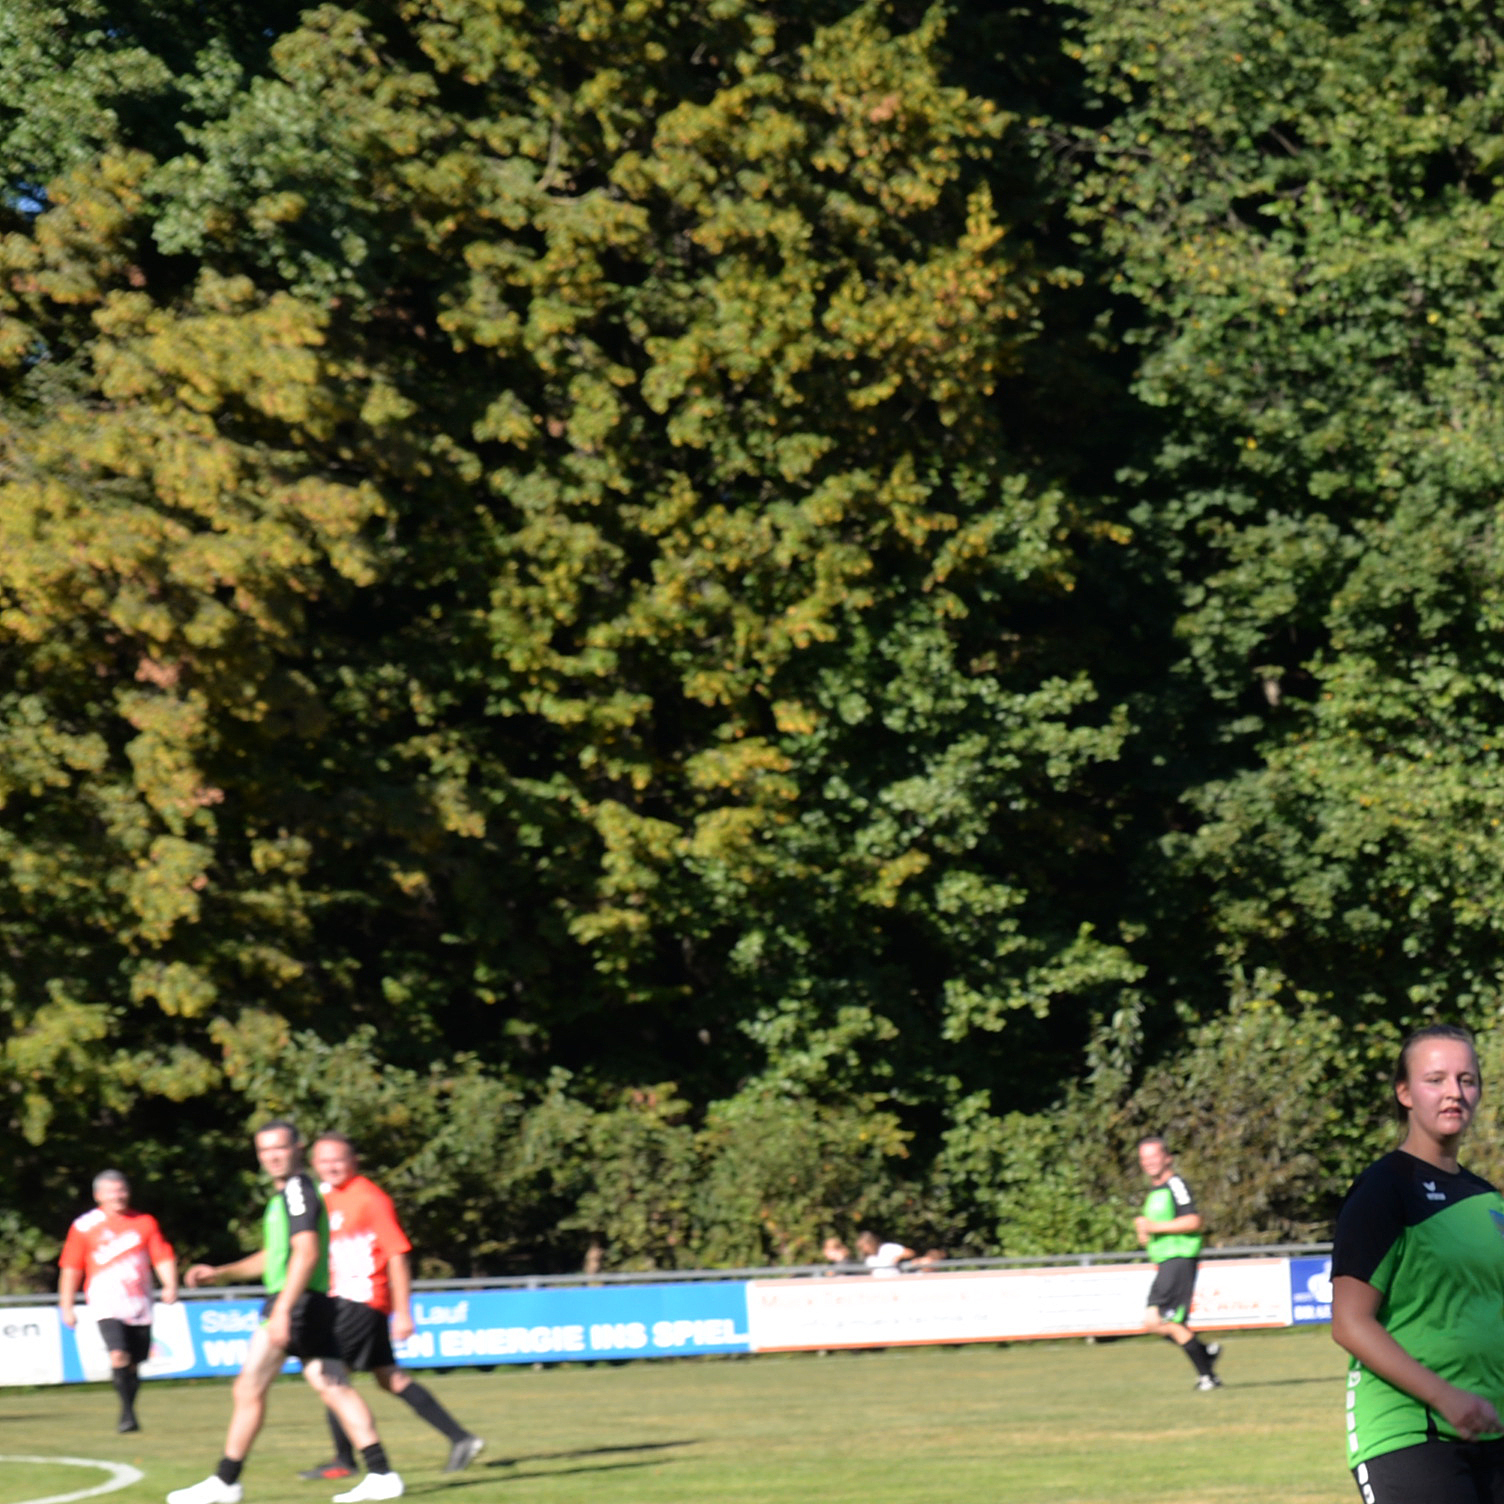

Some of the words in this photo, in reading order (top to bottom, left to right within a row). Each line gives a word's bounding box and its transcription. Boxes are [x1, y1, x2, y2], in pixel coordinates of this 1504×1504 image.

[201, 1309, 260, 1333] Städ
[413, 1300, 469, 1325] Lauf
[439, 1325, 586, 1357] ENERGIE
[589, 1321, 648, 1350] INS
